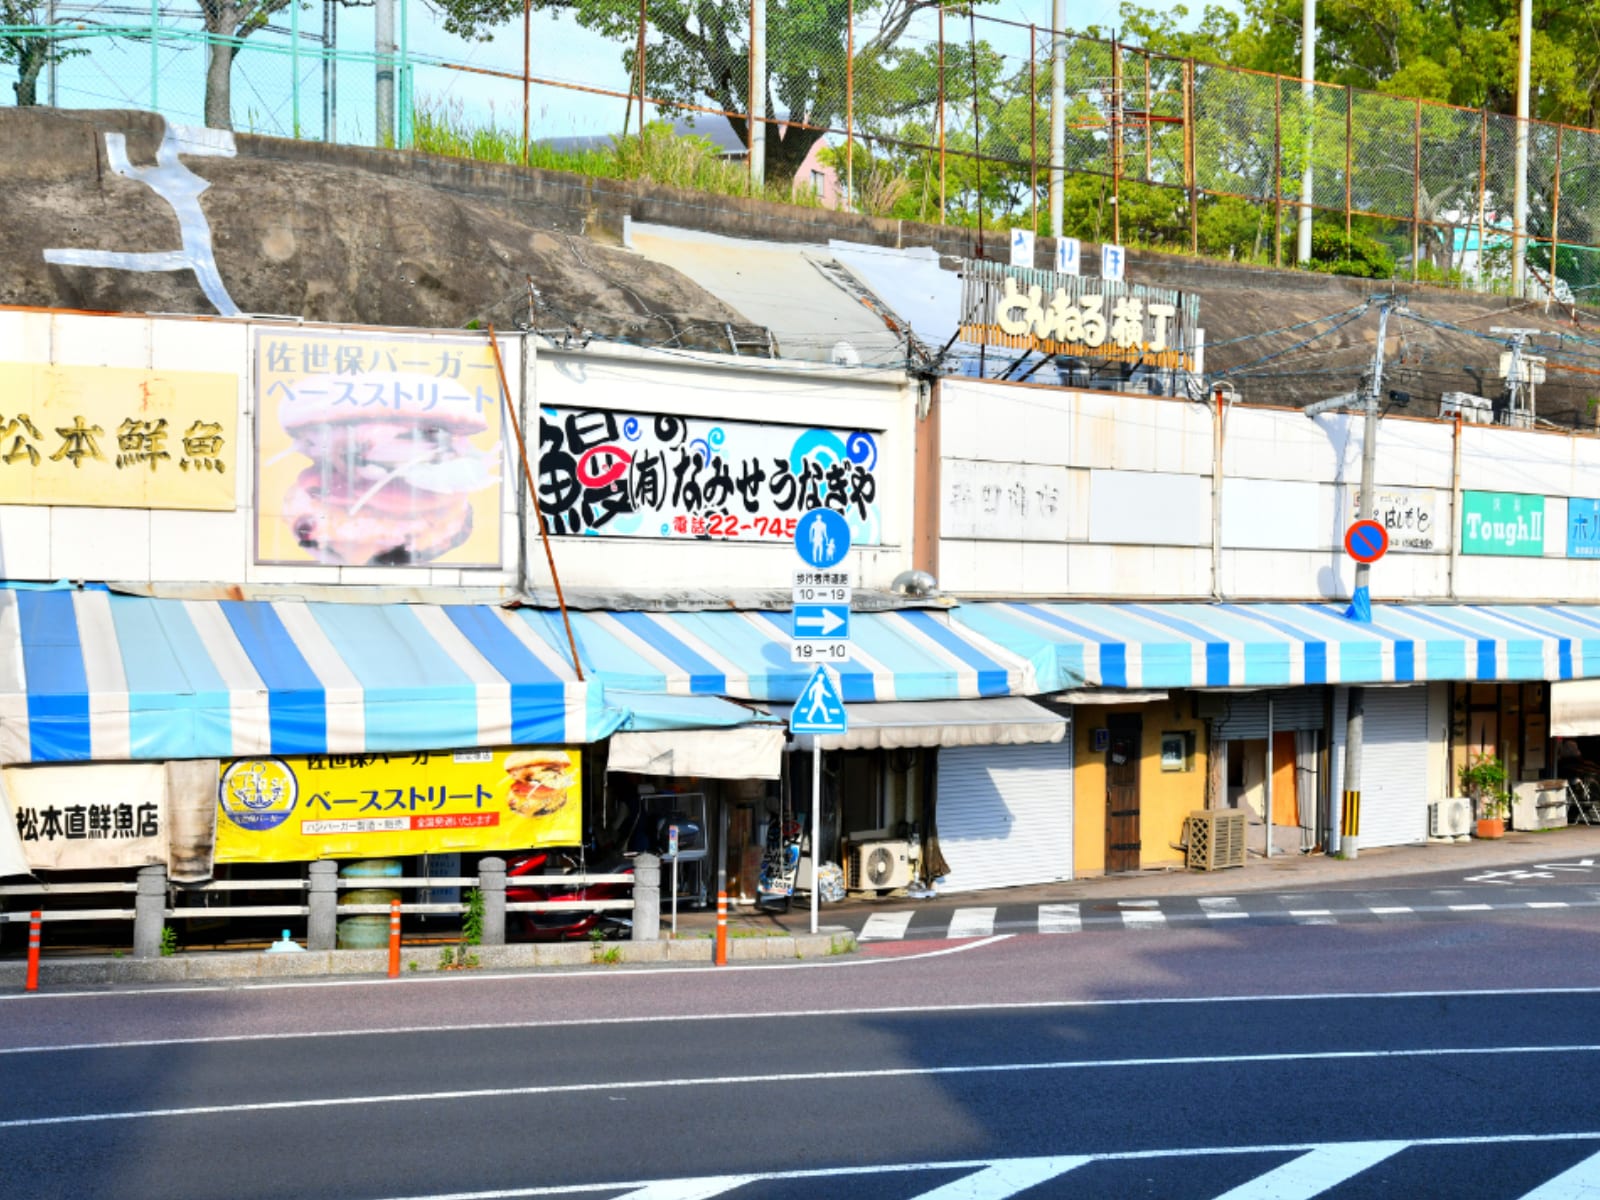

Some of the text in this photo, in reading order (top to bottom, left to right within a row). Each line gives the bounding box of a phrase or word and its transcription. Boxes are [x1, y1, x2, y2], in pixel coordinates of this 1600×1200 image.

[998, 277, 1176, 352] とんねる横丁
[266, 342, 495, 380] 佐世保バーガー
[266, 379, 495, 413] ベースストリート
[0, 414, 226, 474] 松本鮮魚
[796, 573, 848, 585] 歩行者用道路
[305, 783, 493, 812] ベースストリート
[16, 802, 159, 842] 松本直鮮魚店
